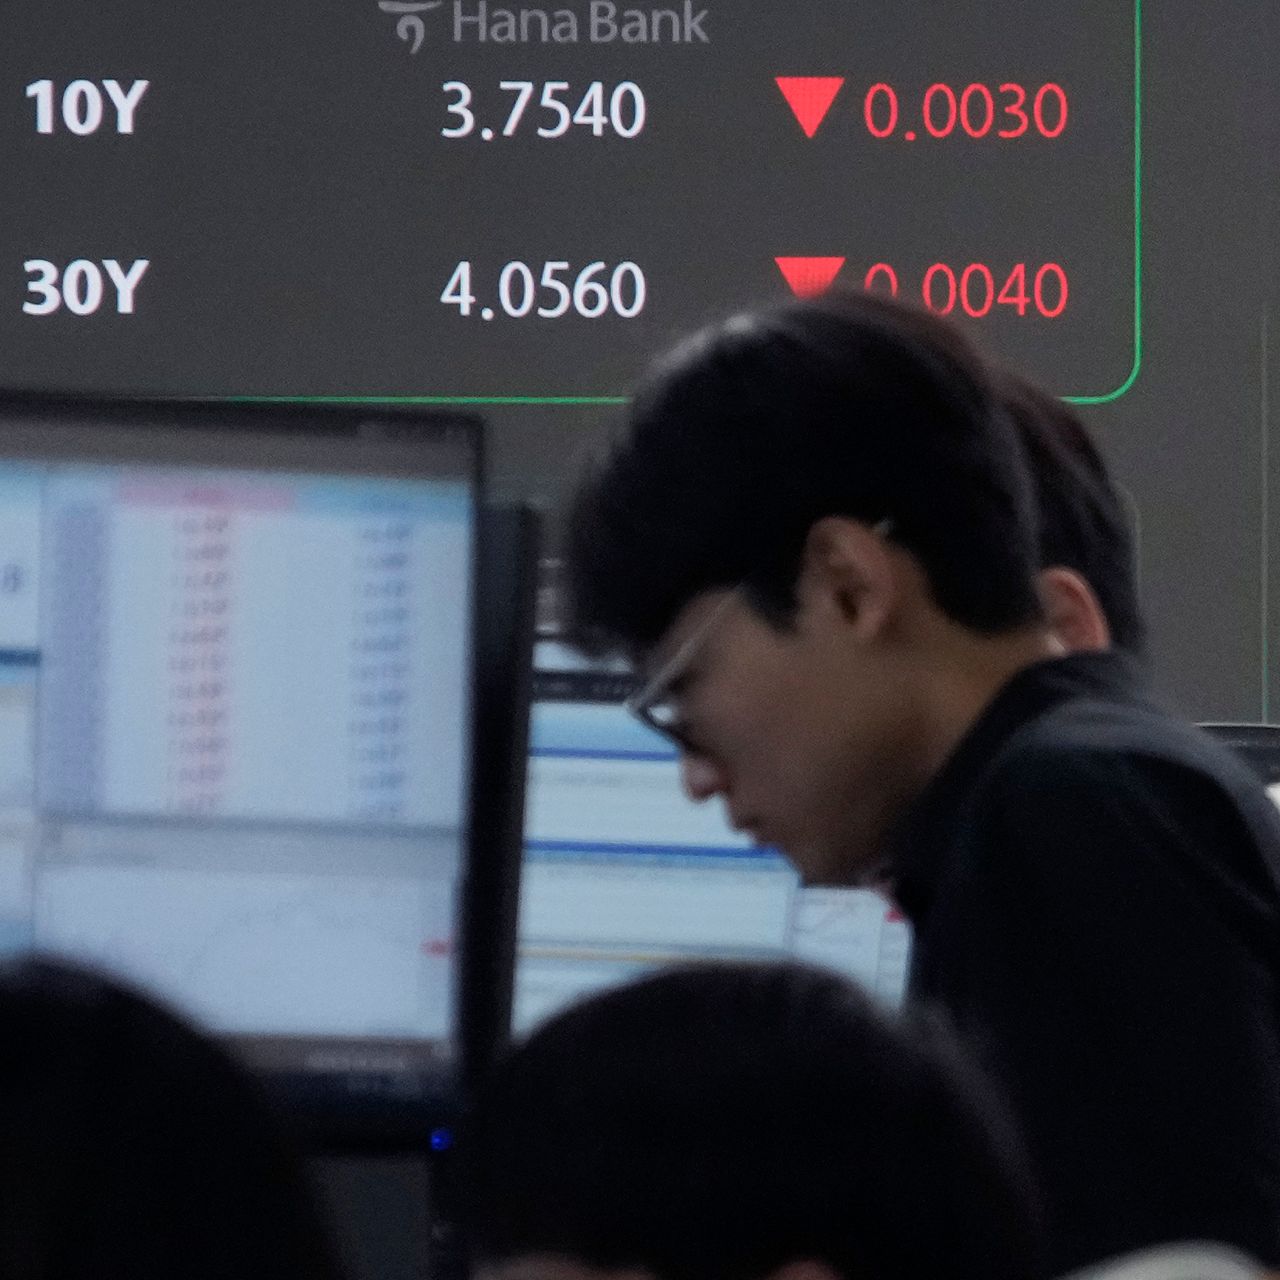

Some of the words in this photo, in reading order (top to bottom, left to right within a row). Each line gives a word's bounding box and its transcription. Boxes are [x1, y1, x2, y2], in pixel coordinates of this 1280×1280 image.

[453, 0, 578, 43] Hana
[589, 0, 709, 43] Bank
[25, 80, 150, 136] 10Y
[441, 81, 646, 141] 3.7540
[863, 83, 1068, 141] 0.0030
[22, 259, 150, 316] 30Y
[440, 261, 646, 321] 4.0560
